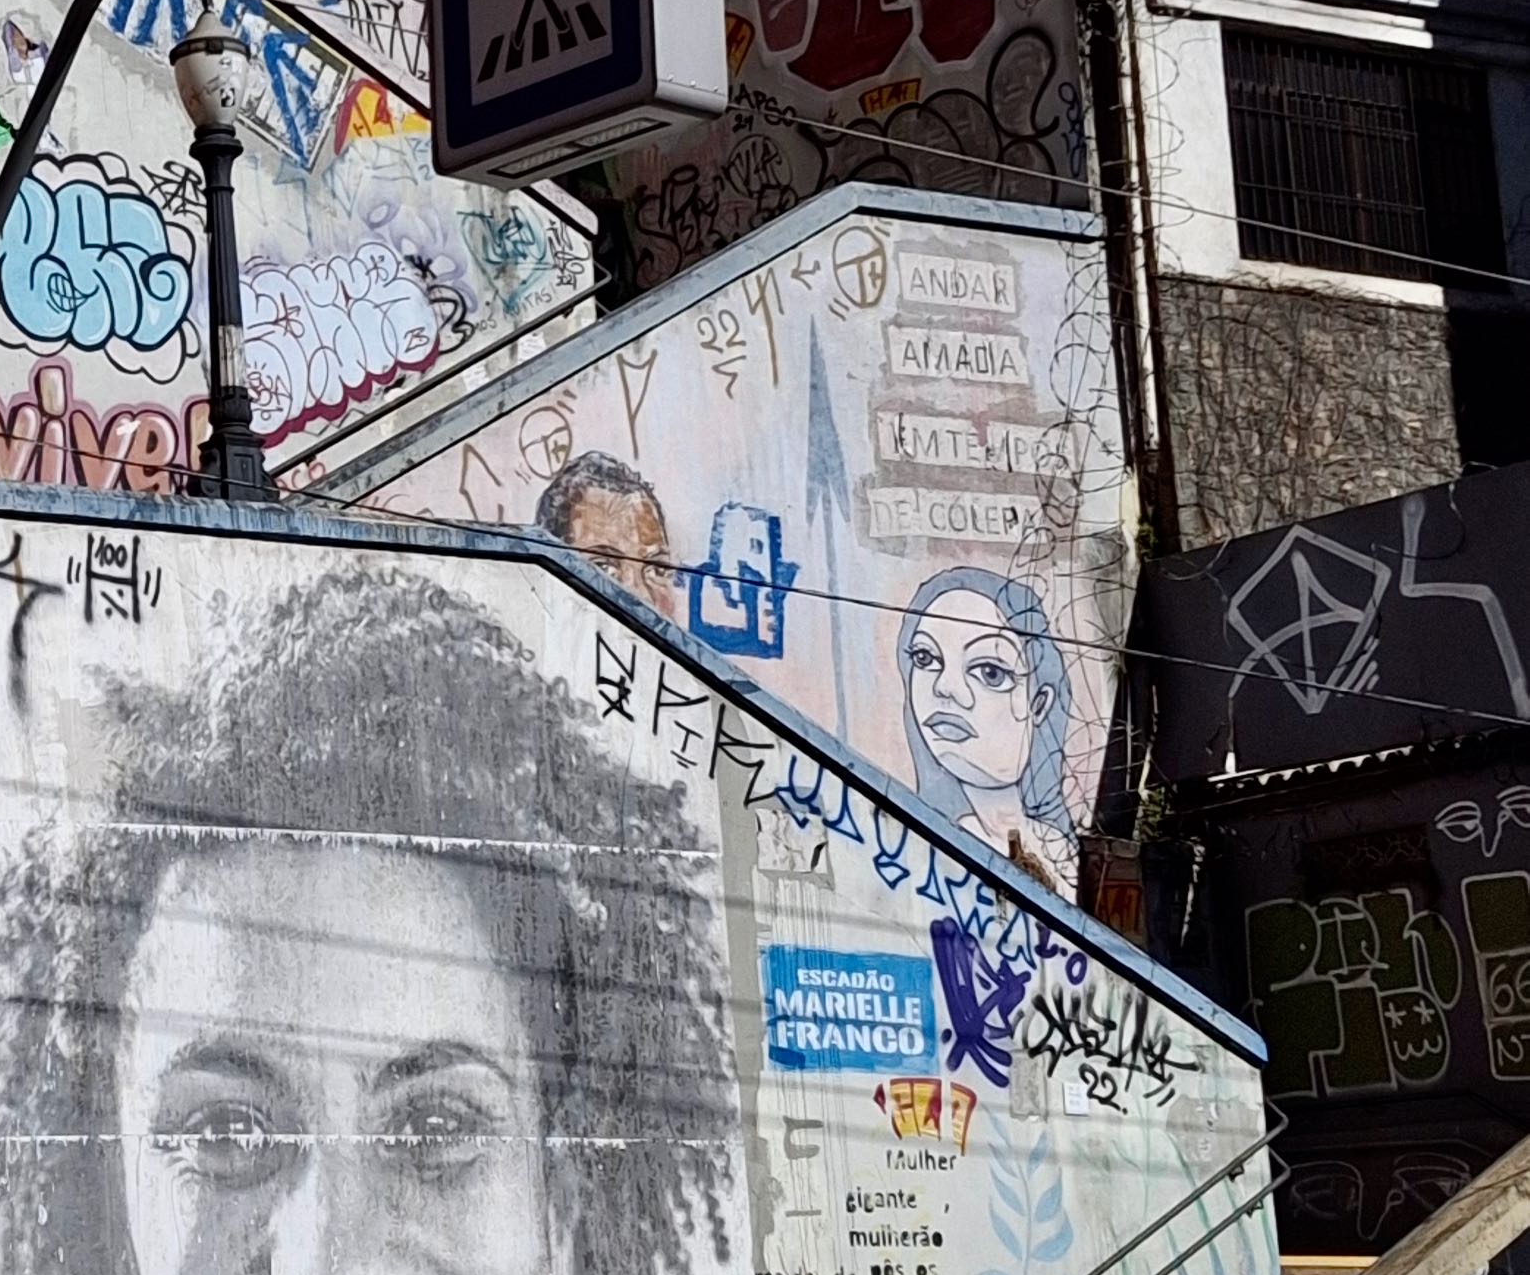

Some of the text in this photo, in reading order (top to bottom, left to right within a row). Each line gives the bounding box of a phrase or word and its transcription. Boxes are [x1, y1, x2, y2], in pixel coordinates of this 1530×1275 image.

[910, 268, 1012, 306] ANDAR
[797, 969, 896, 993] ESCADÃO
[775, 989, 922, 1025] MARIELLE
[776, 1020, 925, 1056] FRANCO
[886, 1149, 957, 1172] Mulher
